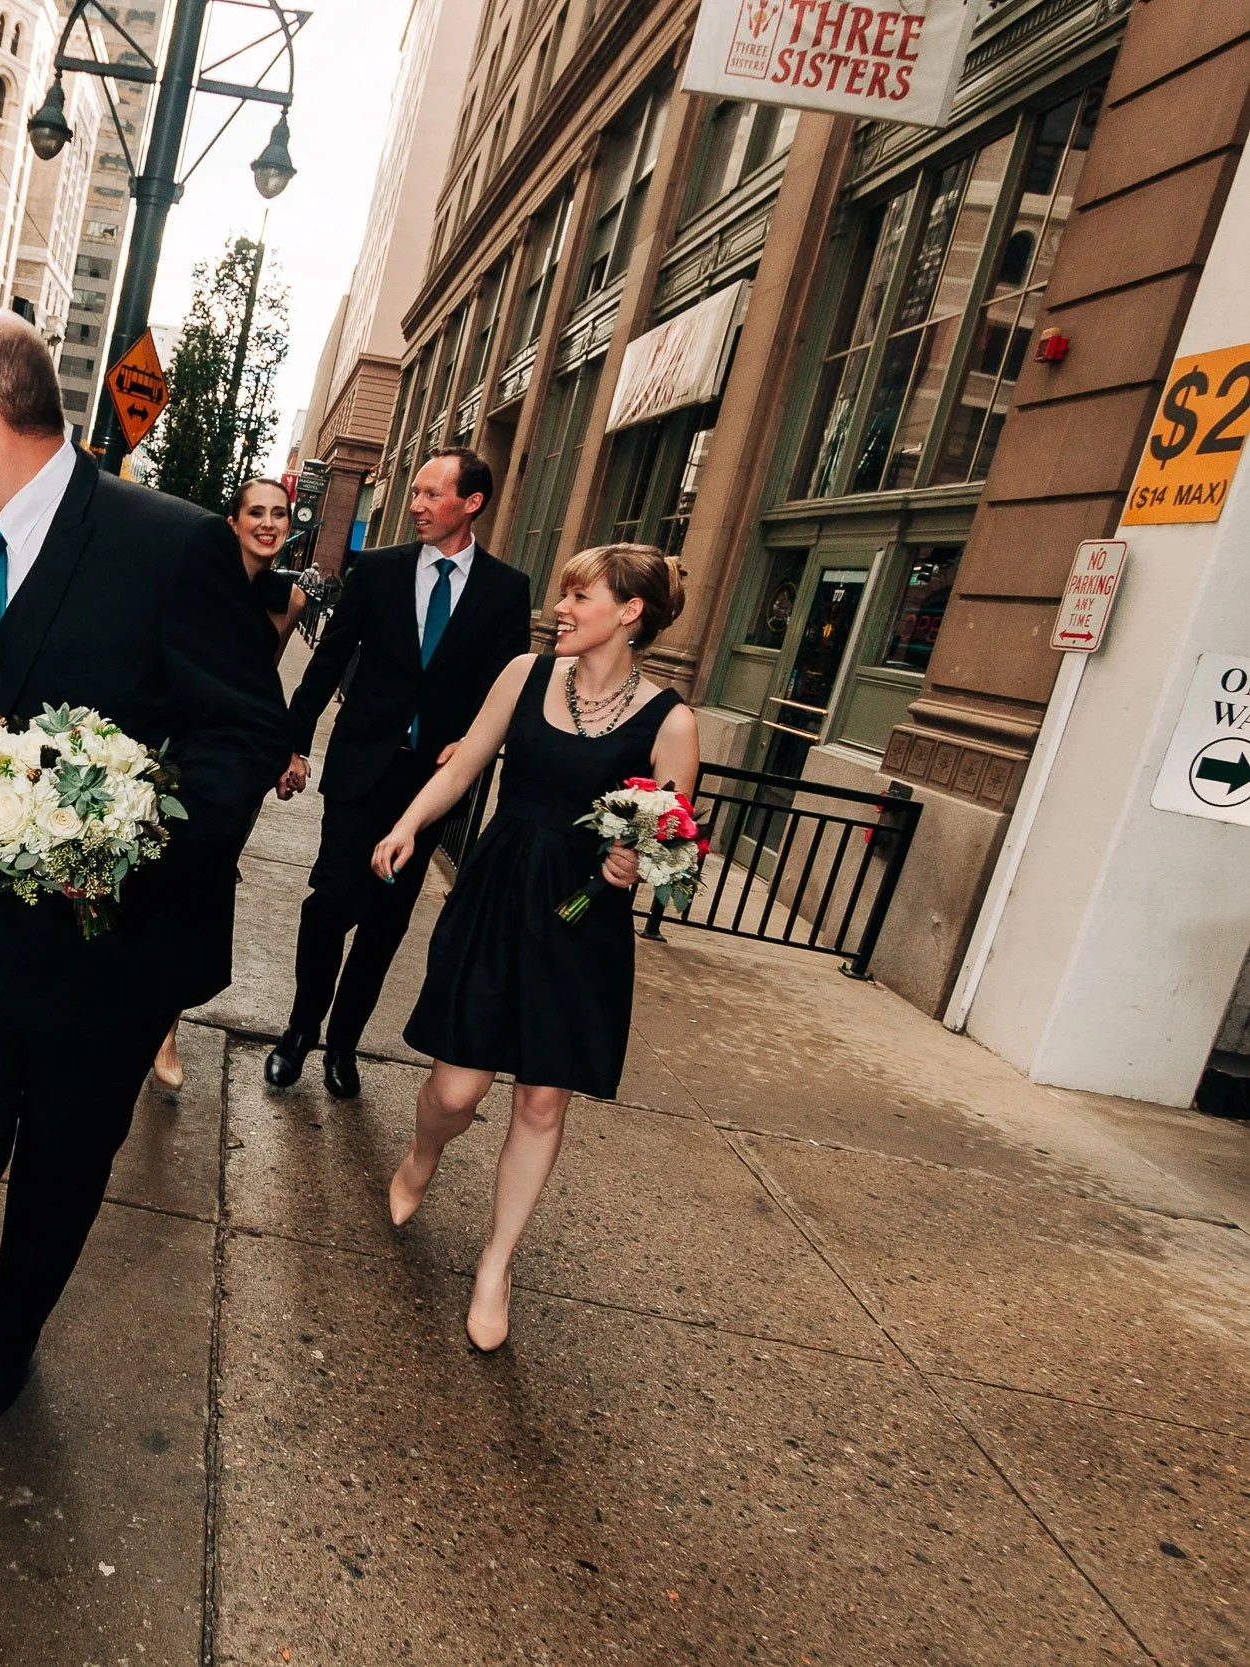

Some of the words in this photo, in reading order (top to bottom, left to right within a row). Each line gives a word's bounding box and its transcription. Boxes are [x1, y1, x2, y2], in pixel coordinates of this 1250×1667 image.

[789, 0, 925, 62] THREE
[735, 42, 768, 57] THREE
[730, 58, 764, 71] SISTERS
[771, 48, 913, 101] SISTERS
[1151, 361, 1250, 471] $2
[1130, 486, 1168, 510] ($14
[1173, 479, 1228, 506] MAX)
[1087, 550, 1107, 571] NO
[1068, 575, 1114, 595] PARKING
[1074, 598, 1095, 611] ANY
[900, 613, 943, 643] OPE
[1069, 613, 1092, 628] TIME
